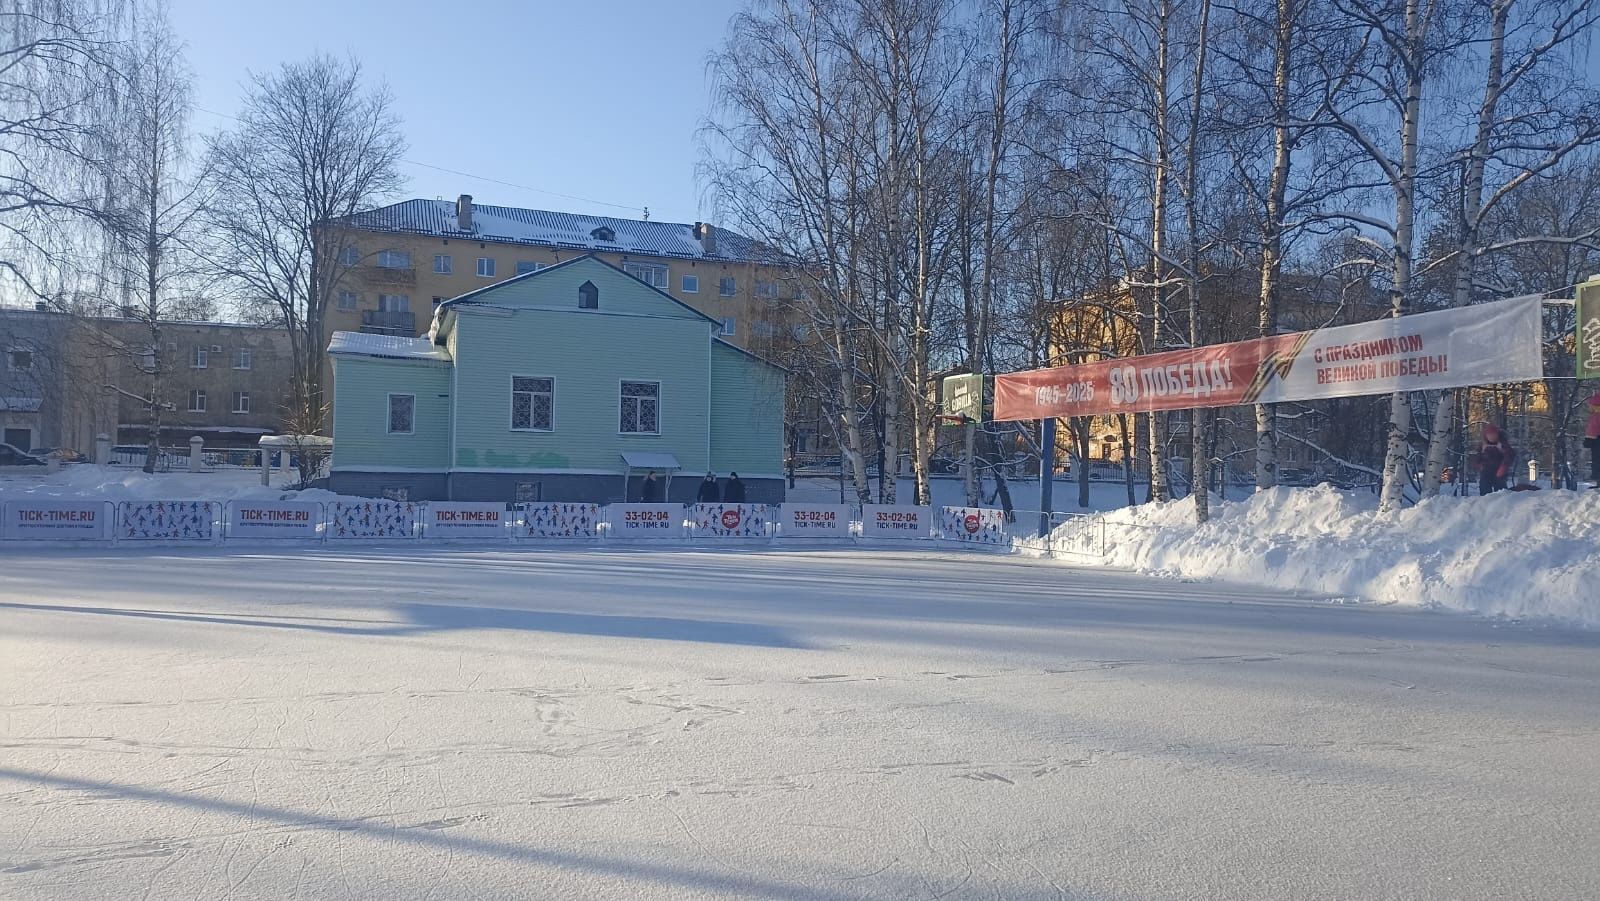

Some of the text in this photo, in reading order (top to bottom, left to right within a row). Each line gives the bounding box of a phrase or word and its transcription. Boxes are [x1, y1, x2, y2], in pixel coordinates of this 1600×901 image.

[1314, 334, 1424, 364] С ПРАЗДНИКОМ
[1317, 354, 1449, 385] ВЕЛИКОЙ ПОБЕДЫ!
[1110, 365, 1139, 405] 80
[1141, 358, 1233, 399] ПОБЕДА!
[18, 510, 95, 522] TICK-TIME.RU
[240, 509, 309, 521] TICK-TIME.RU
[436, 511, 499, 521] TICK-TIME.RU
[625, 511, 669, 520] 33-02-04
[794, 511, 835, 521] 33-02-04
[876, 512, 917, 522] 33-02-04
